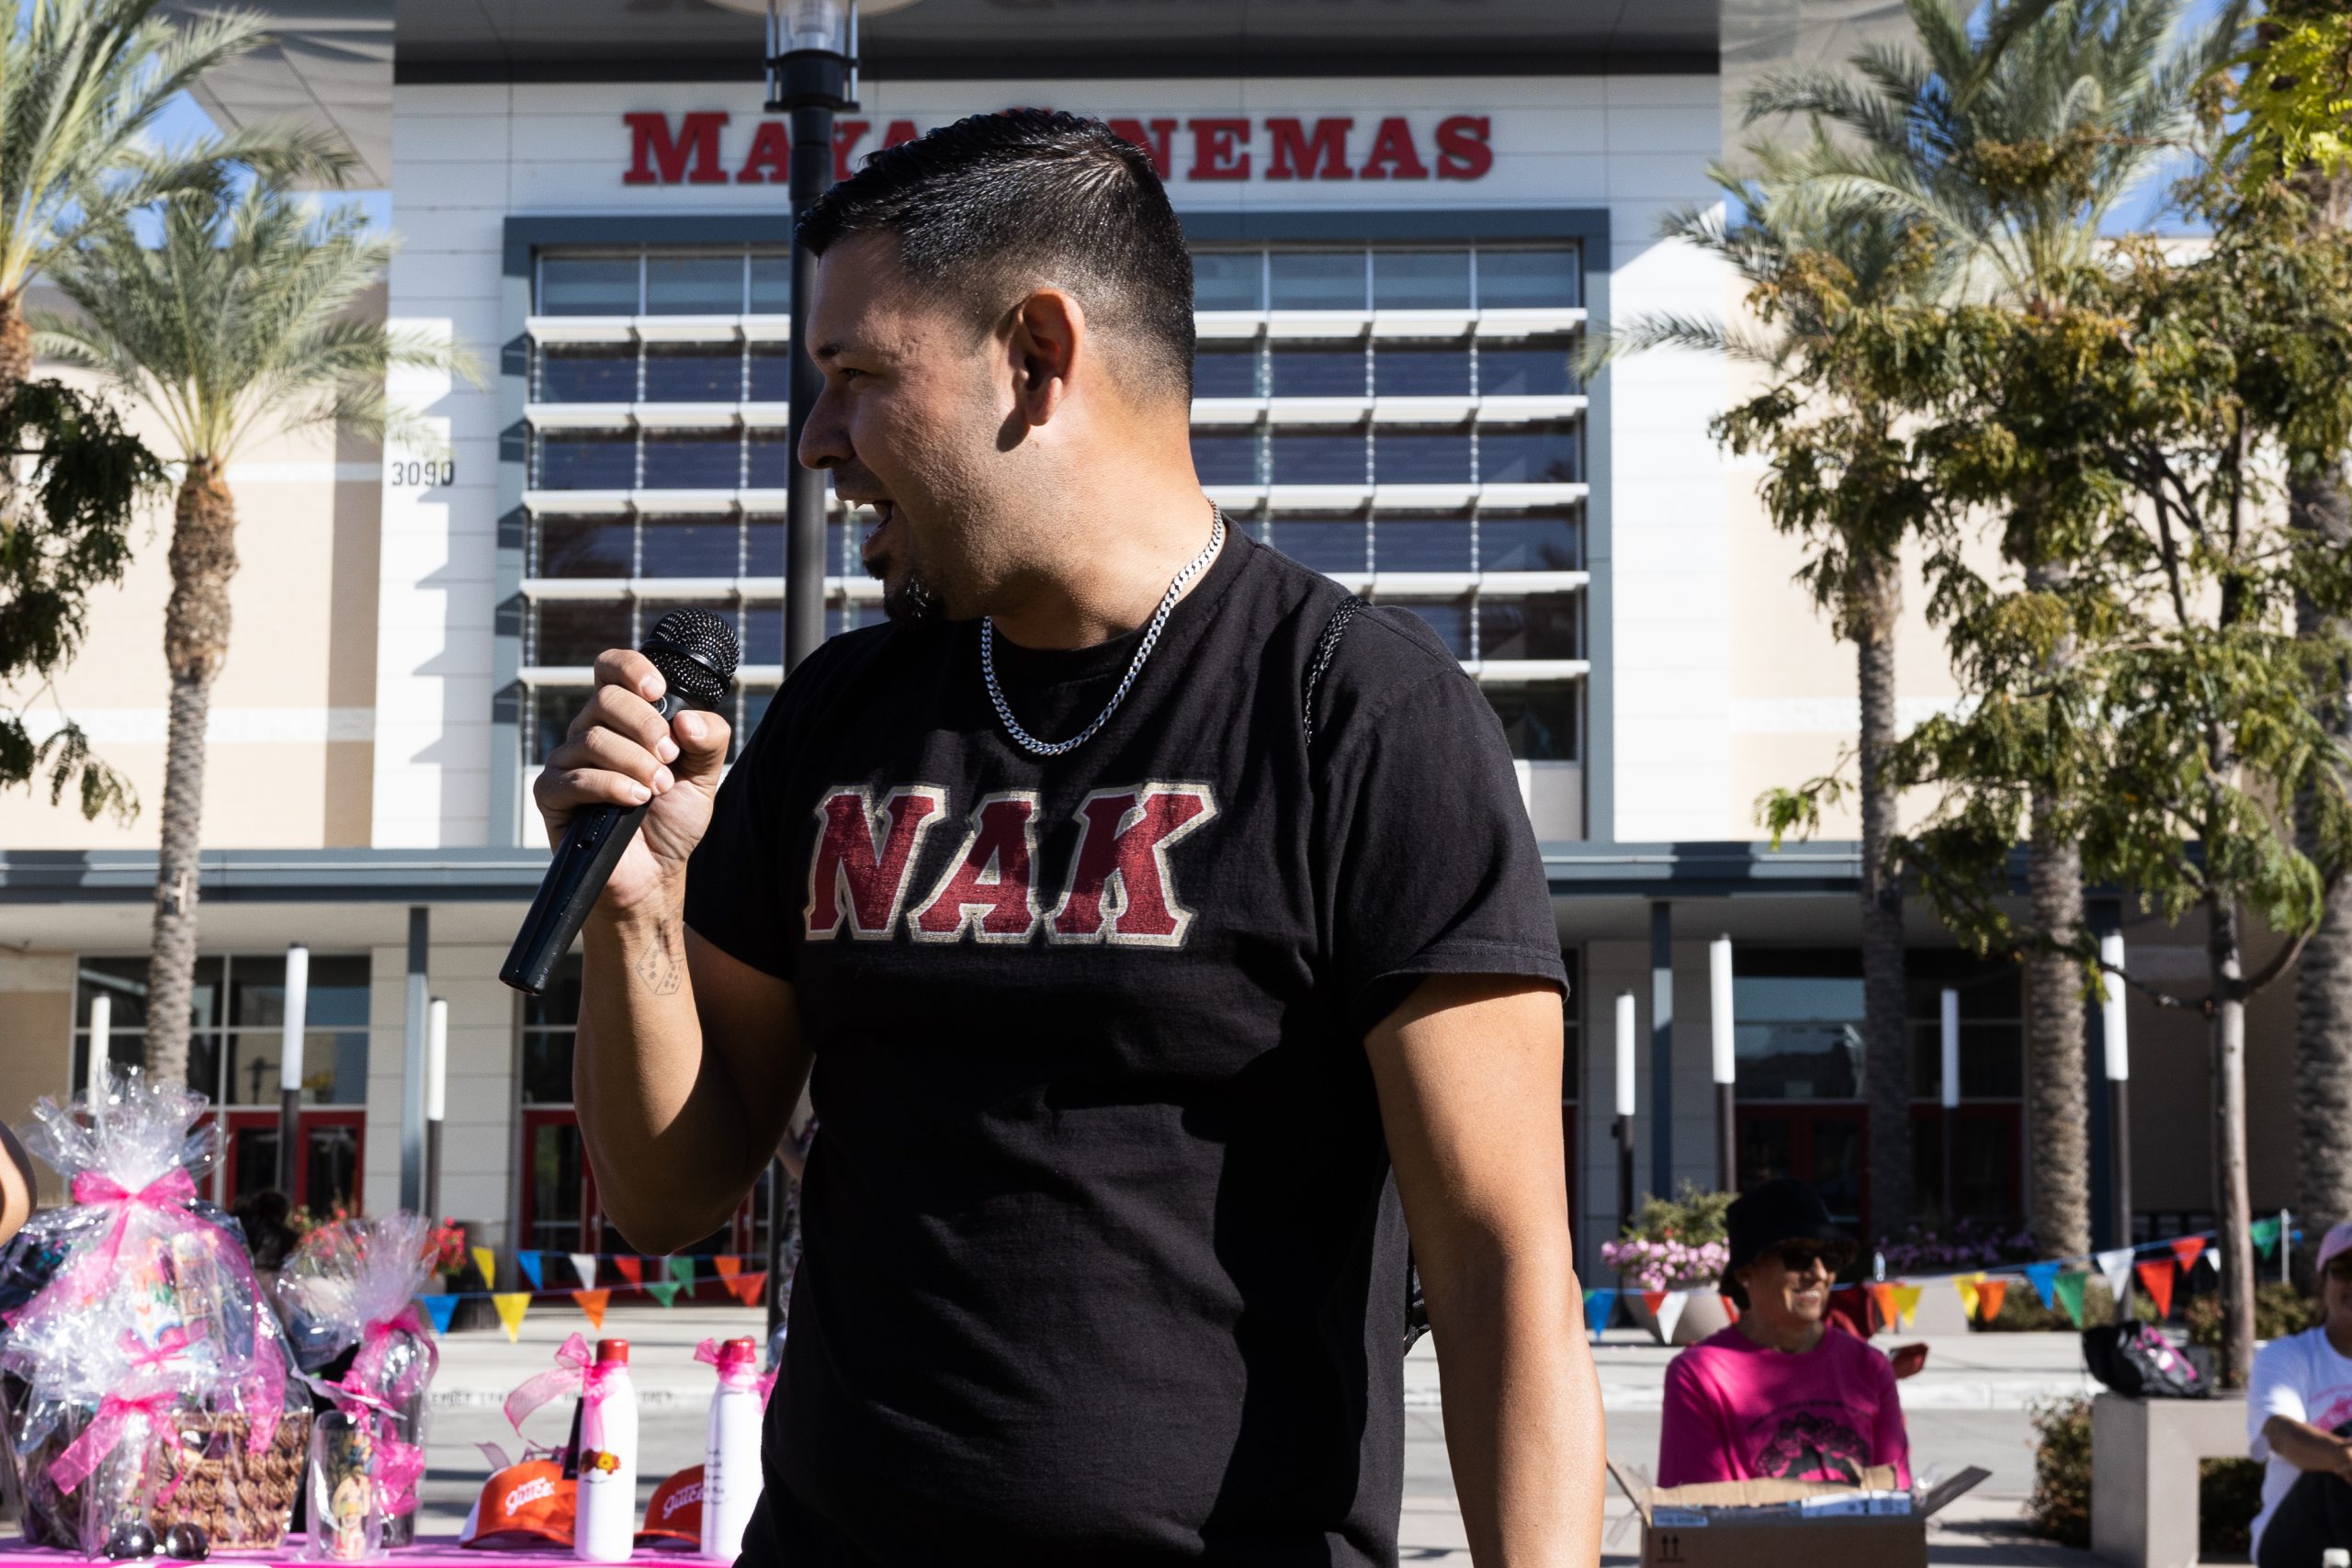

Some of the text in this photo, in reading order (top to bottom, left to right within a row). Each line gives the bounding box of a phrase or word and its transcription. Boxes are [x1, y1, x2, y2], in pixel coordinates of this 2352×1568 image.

[1000, 108, 1494, 181] NEMAS
[391, 461, 454, 486] 3090
[804, 781, 1218, 949] NAK
